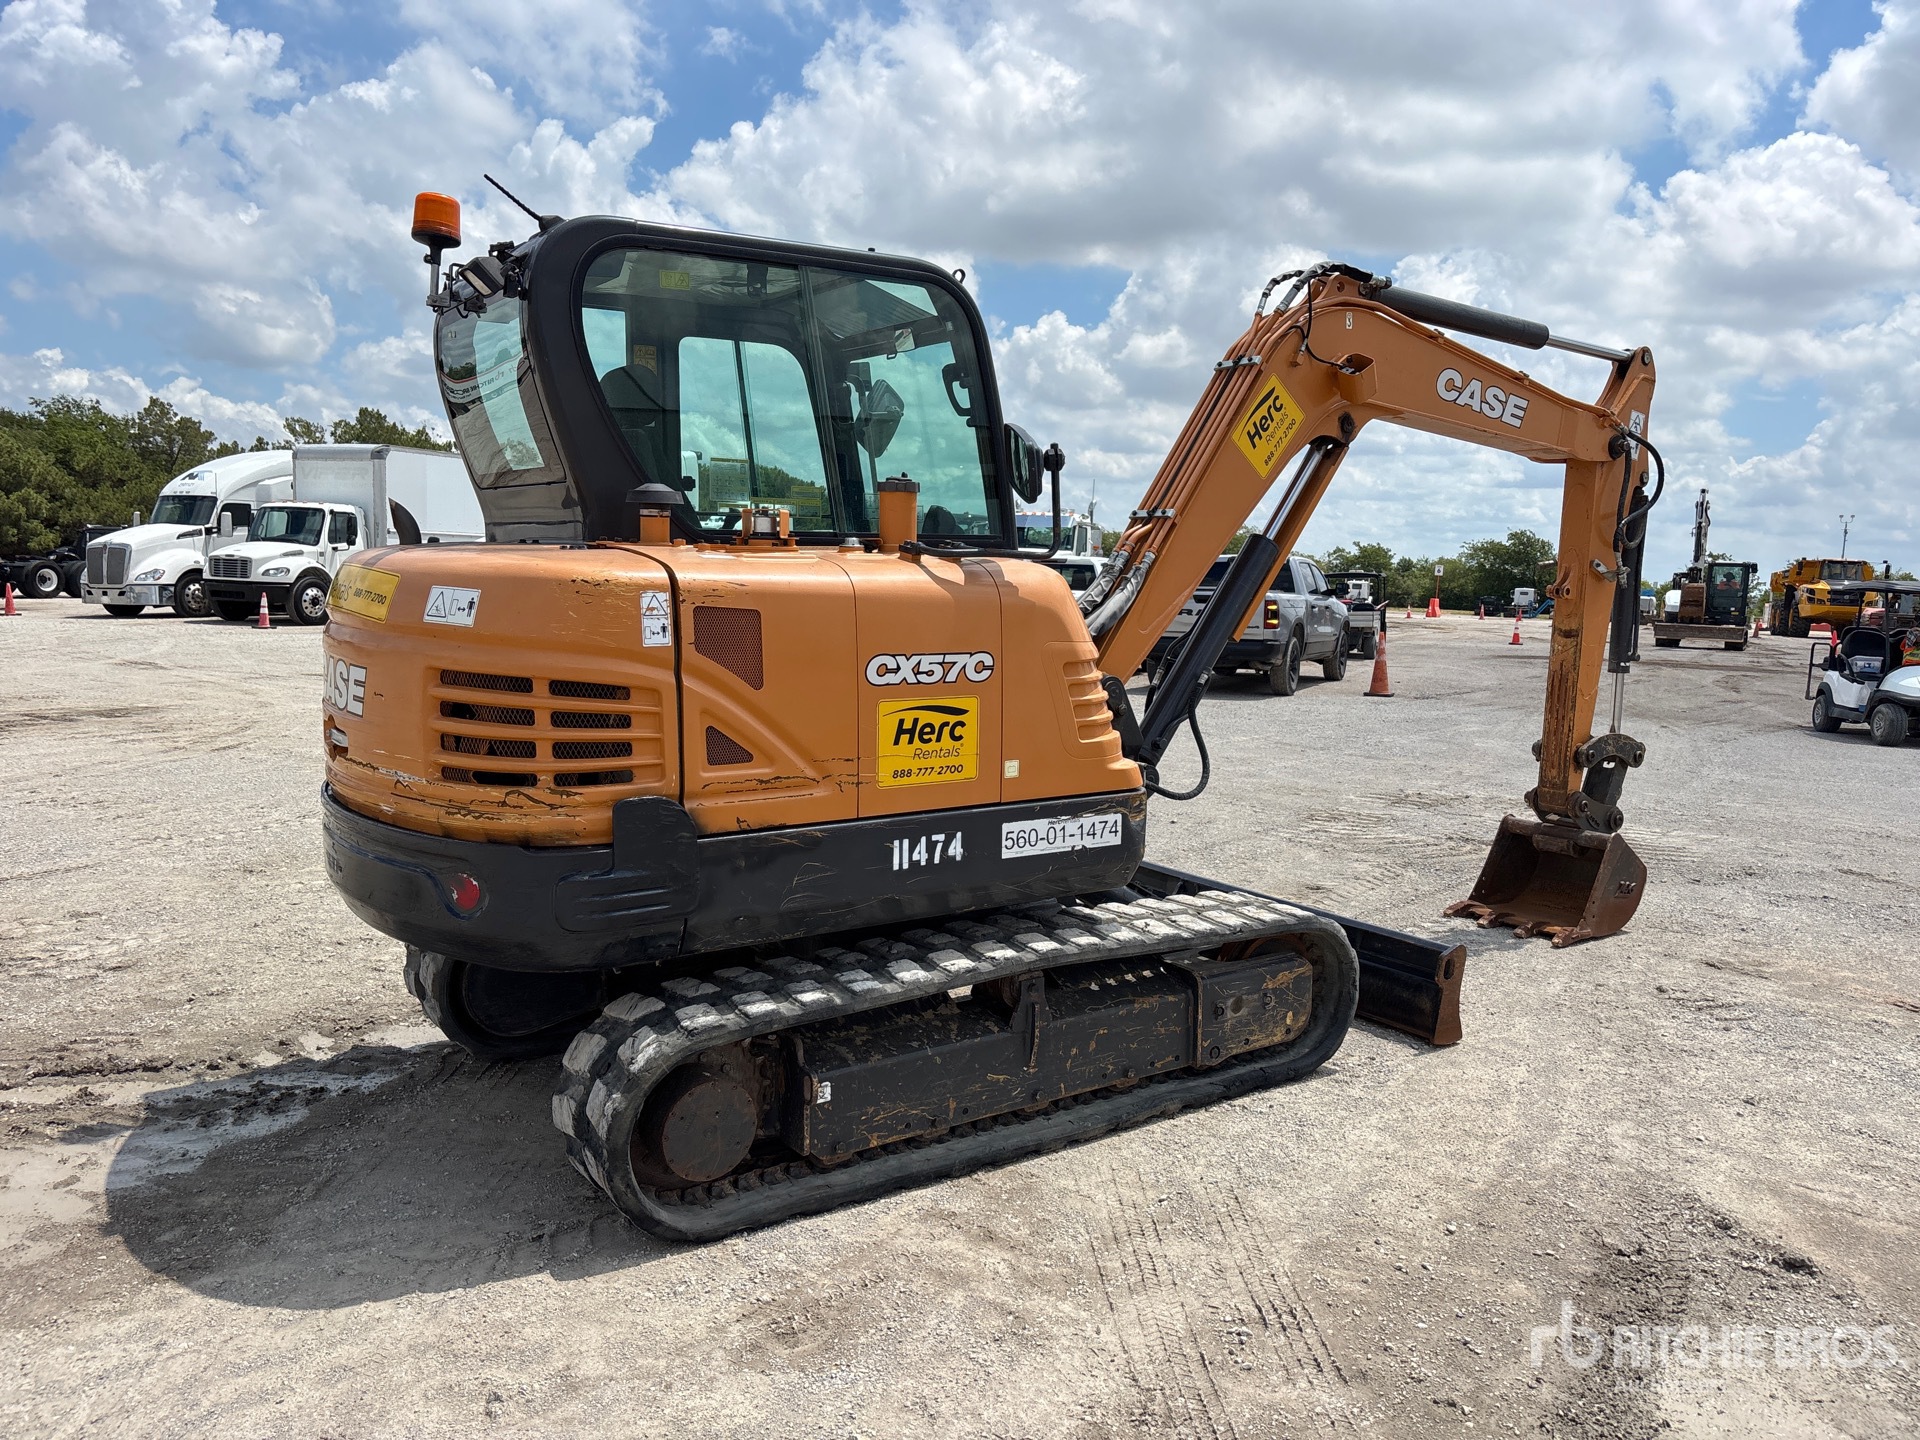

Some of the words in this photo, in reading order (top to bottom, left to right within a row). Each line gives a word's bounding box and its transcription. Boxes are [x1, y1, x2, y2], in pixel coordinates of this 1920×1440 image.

[1436, 368, 1529, 429] CASE
[1247, 394, 1284, 450] Herc
[1265, 411, 1289, 446] Rentals
[1264, 418, 1297, 467] 888-777-2700
[354, 587, 387, 605] 888-777-2700
[323, 650, 368, 718] ASE
[865, 651, 995, 687] CX57C
[893, 717, 966, 746] Herc
[892, 764, 964, 780] 888-777-2700
[893, 832, 964, 871] 11474
[1004, 819, 1120, 851] 560-01-1474
